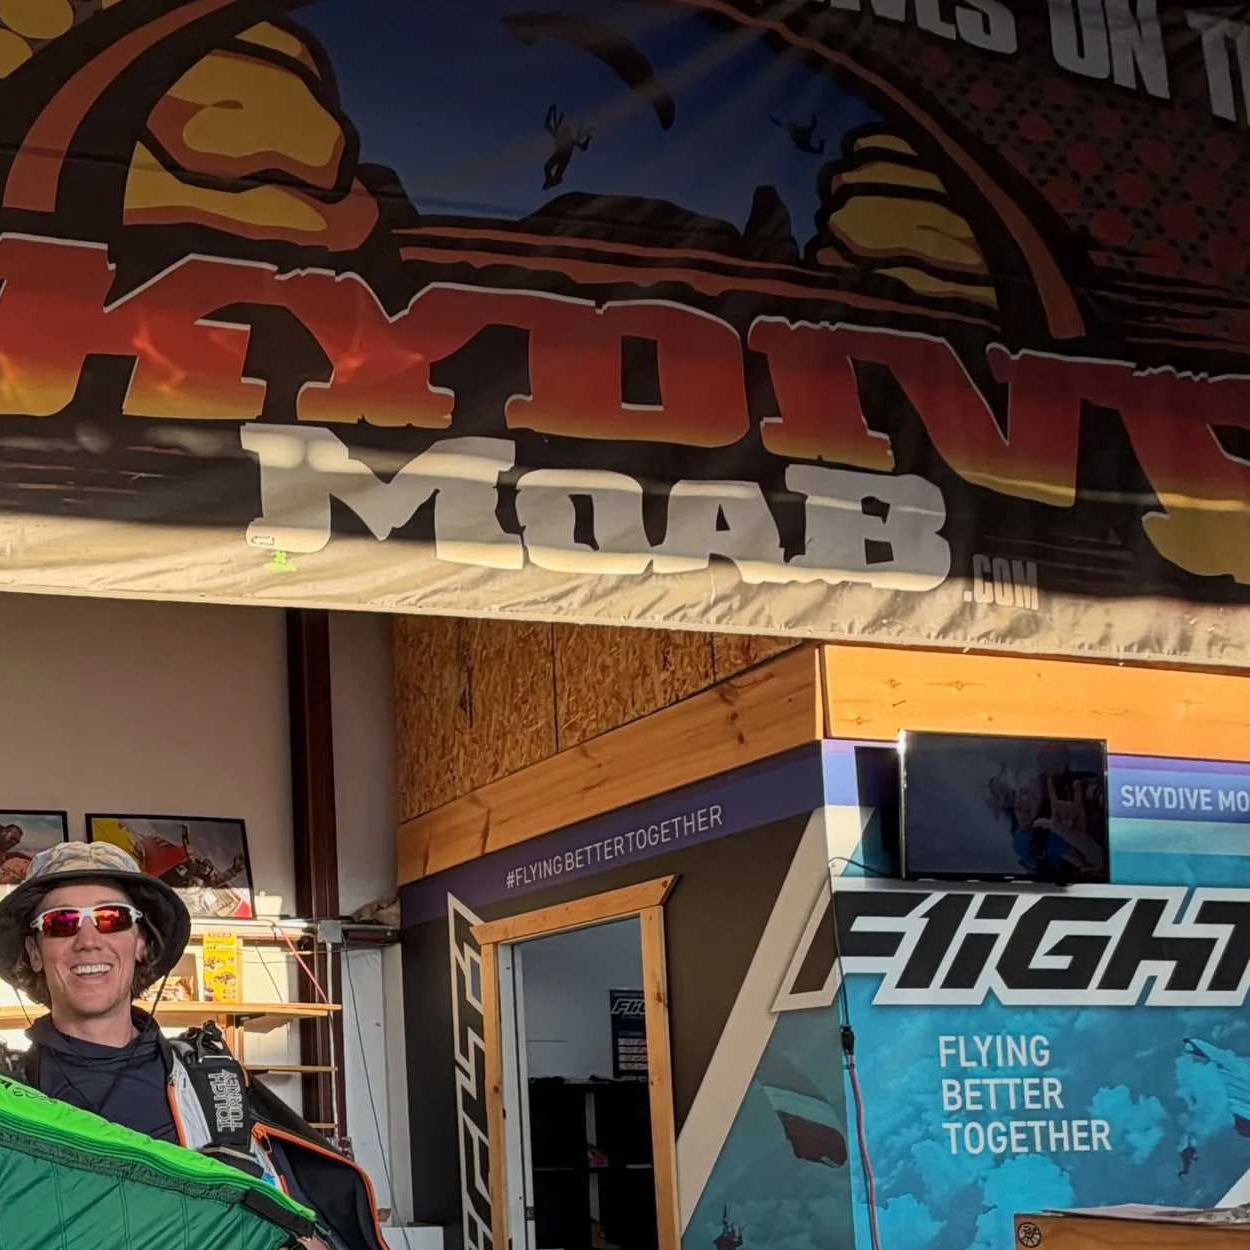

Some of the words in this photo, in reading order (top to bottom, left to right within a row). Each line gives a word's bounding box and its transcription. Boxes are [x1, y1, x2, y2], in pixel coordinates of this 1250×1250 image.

[963, 553, 1039, 611] .COM
[1120, 785, 1213, 811] SKYDIVE
[938, 1034, 1050, 1067] FLYING
[207, 1072, 231, 1132] TOUGH
[221, 1068, 244, 1132] TURKEY
[941, 1077, 1064, 1111] BETTER
[941, 1119, 1112, 1154] TOGETHER
